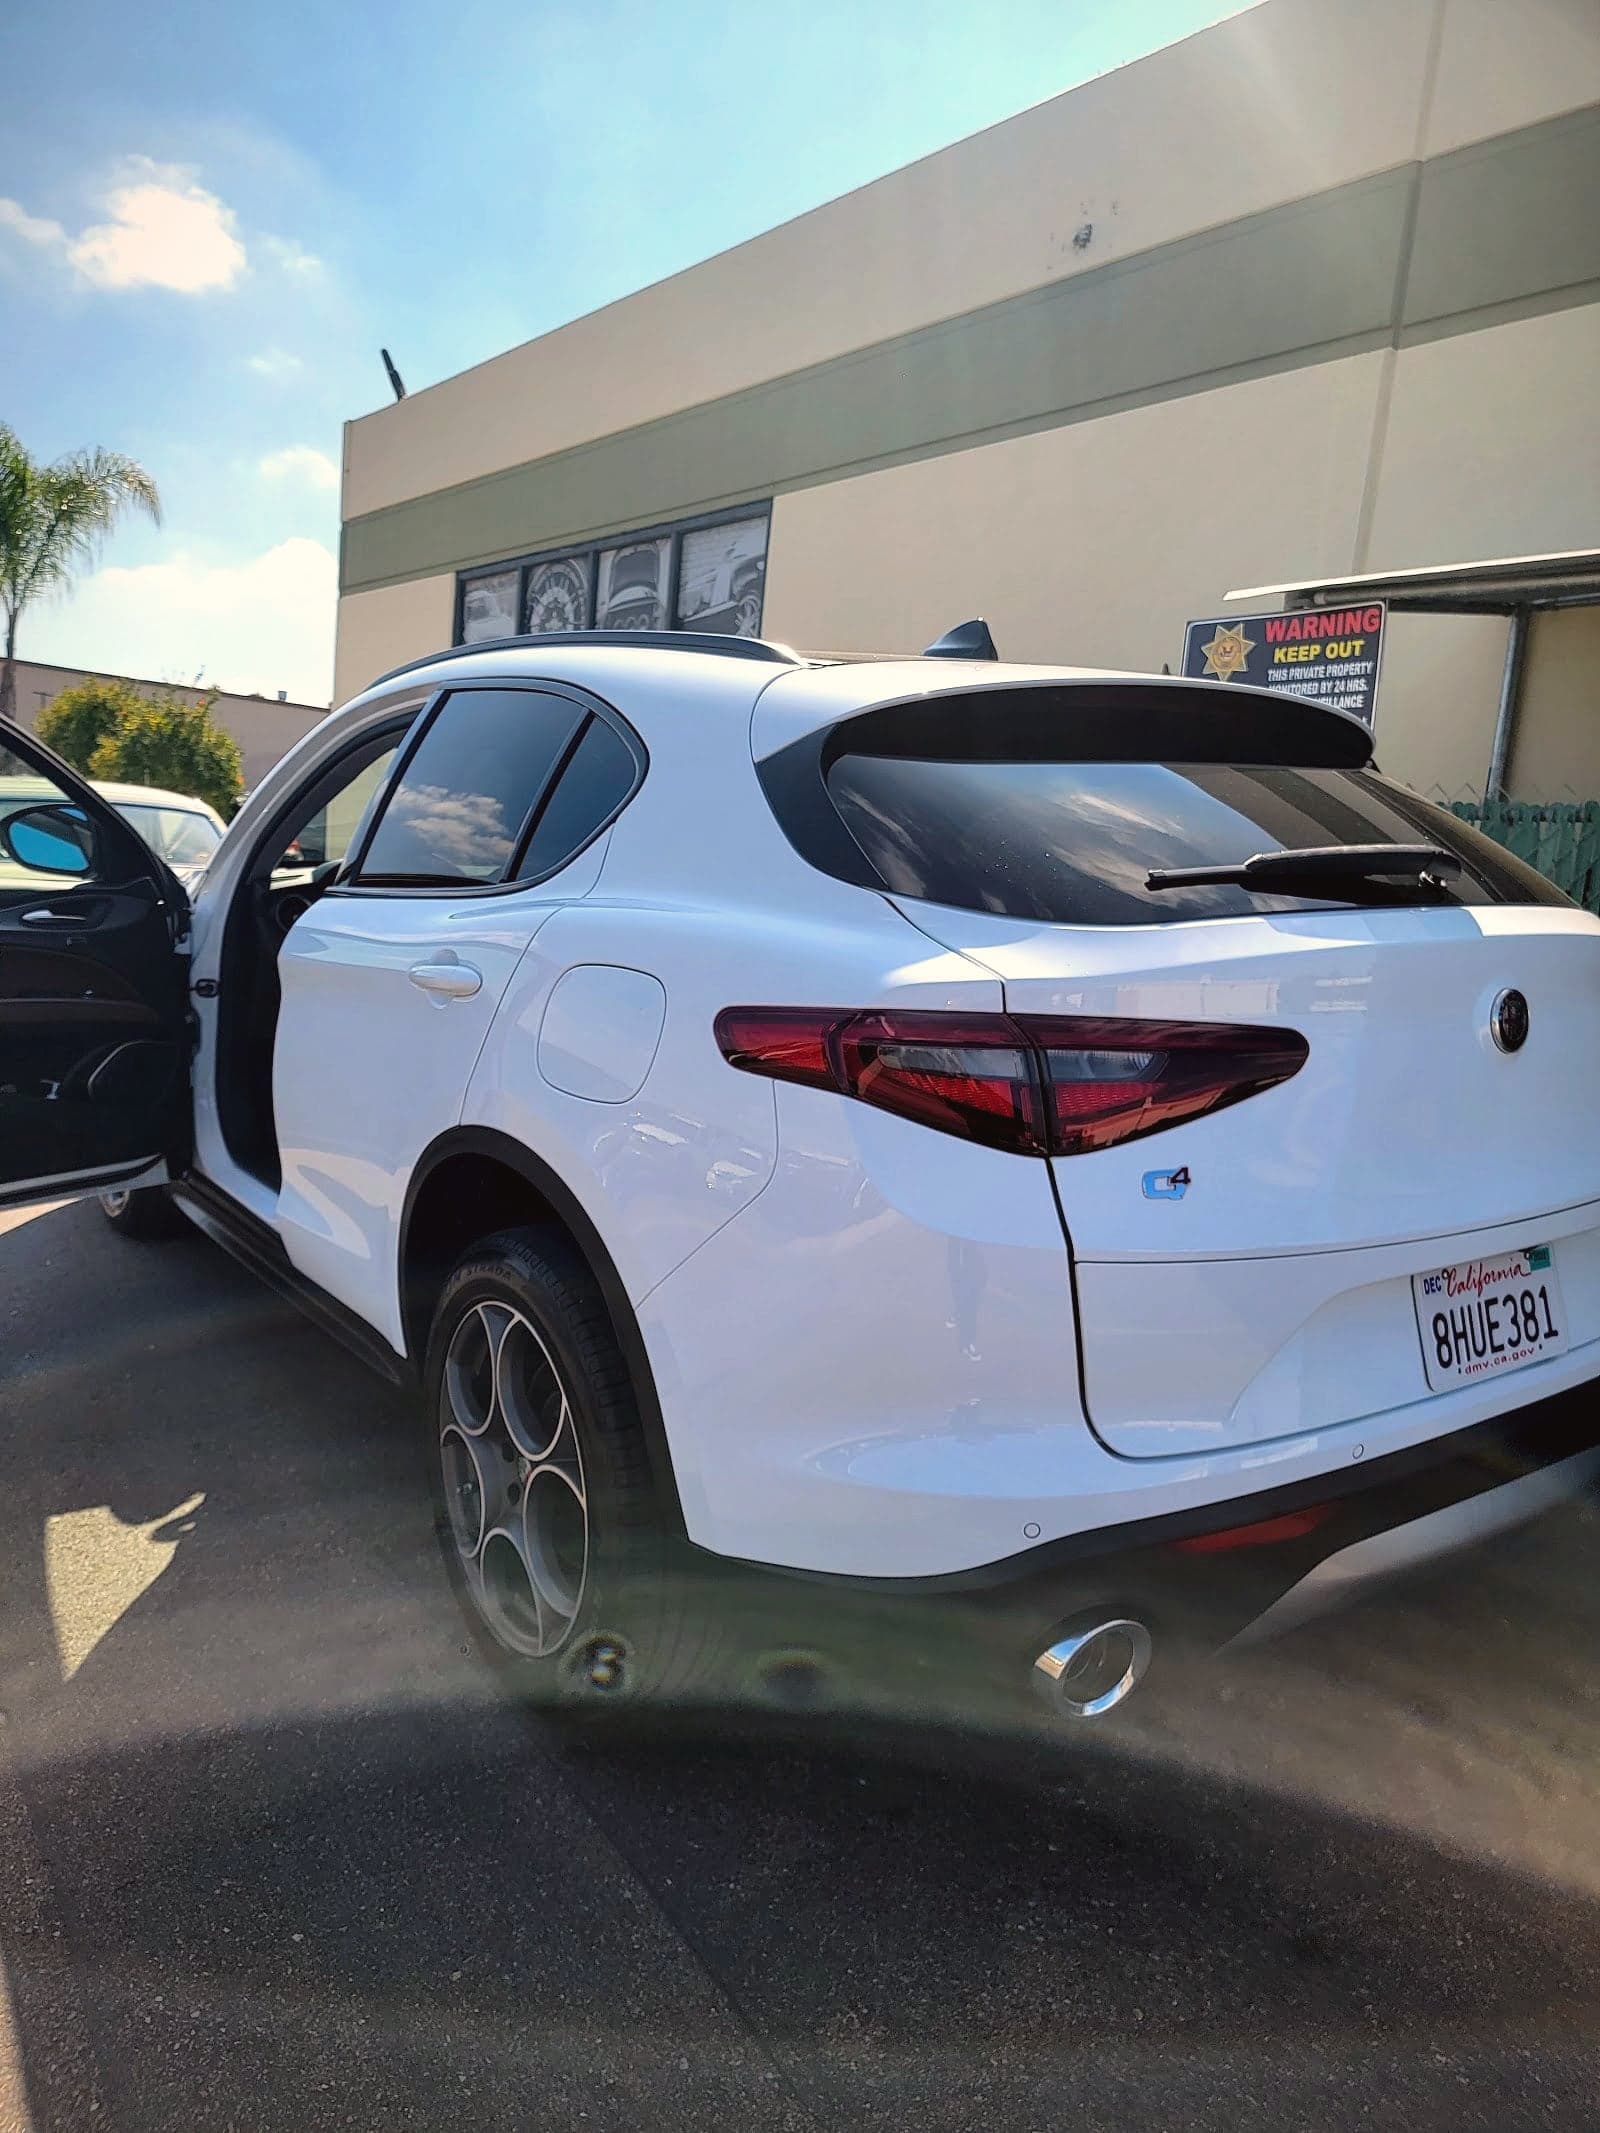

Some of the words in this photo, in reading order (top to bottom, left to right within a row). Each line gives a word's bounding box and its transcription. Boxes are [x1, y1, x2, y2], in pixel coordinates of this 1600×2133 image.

[1265, 608, 1381, 643] WARNING
[1274, 644, 1321, 664] KEEP
[1325, 640, 1365, 660] OUT
[1267, 668, 1288, 682] THIS
[1289, 665, 1326, 681] PRIVATE
[1326, 661, 1373, 678] PROPERTY
[1319, 681, 1334, 694] BY
[1334, 679, 1346, 694] 24
[1423, 1275, 1442, 1295] DEC
[1444, 1258, 1531, 1297] California
[1432, 1285, 1559, 1369] 8HUE381
[1465, 1347, 1535, 1375] dmv.ca.gov
